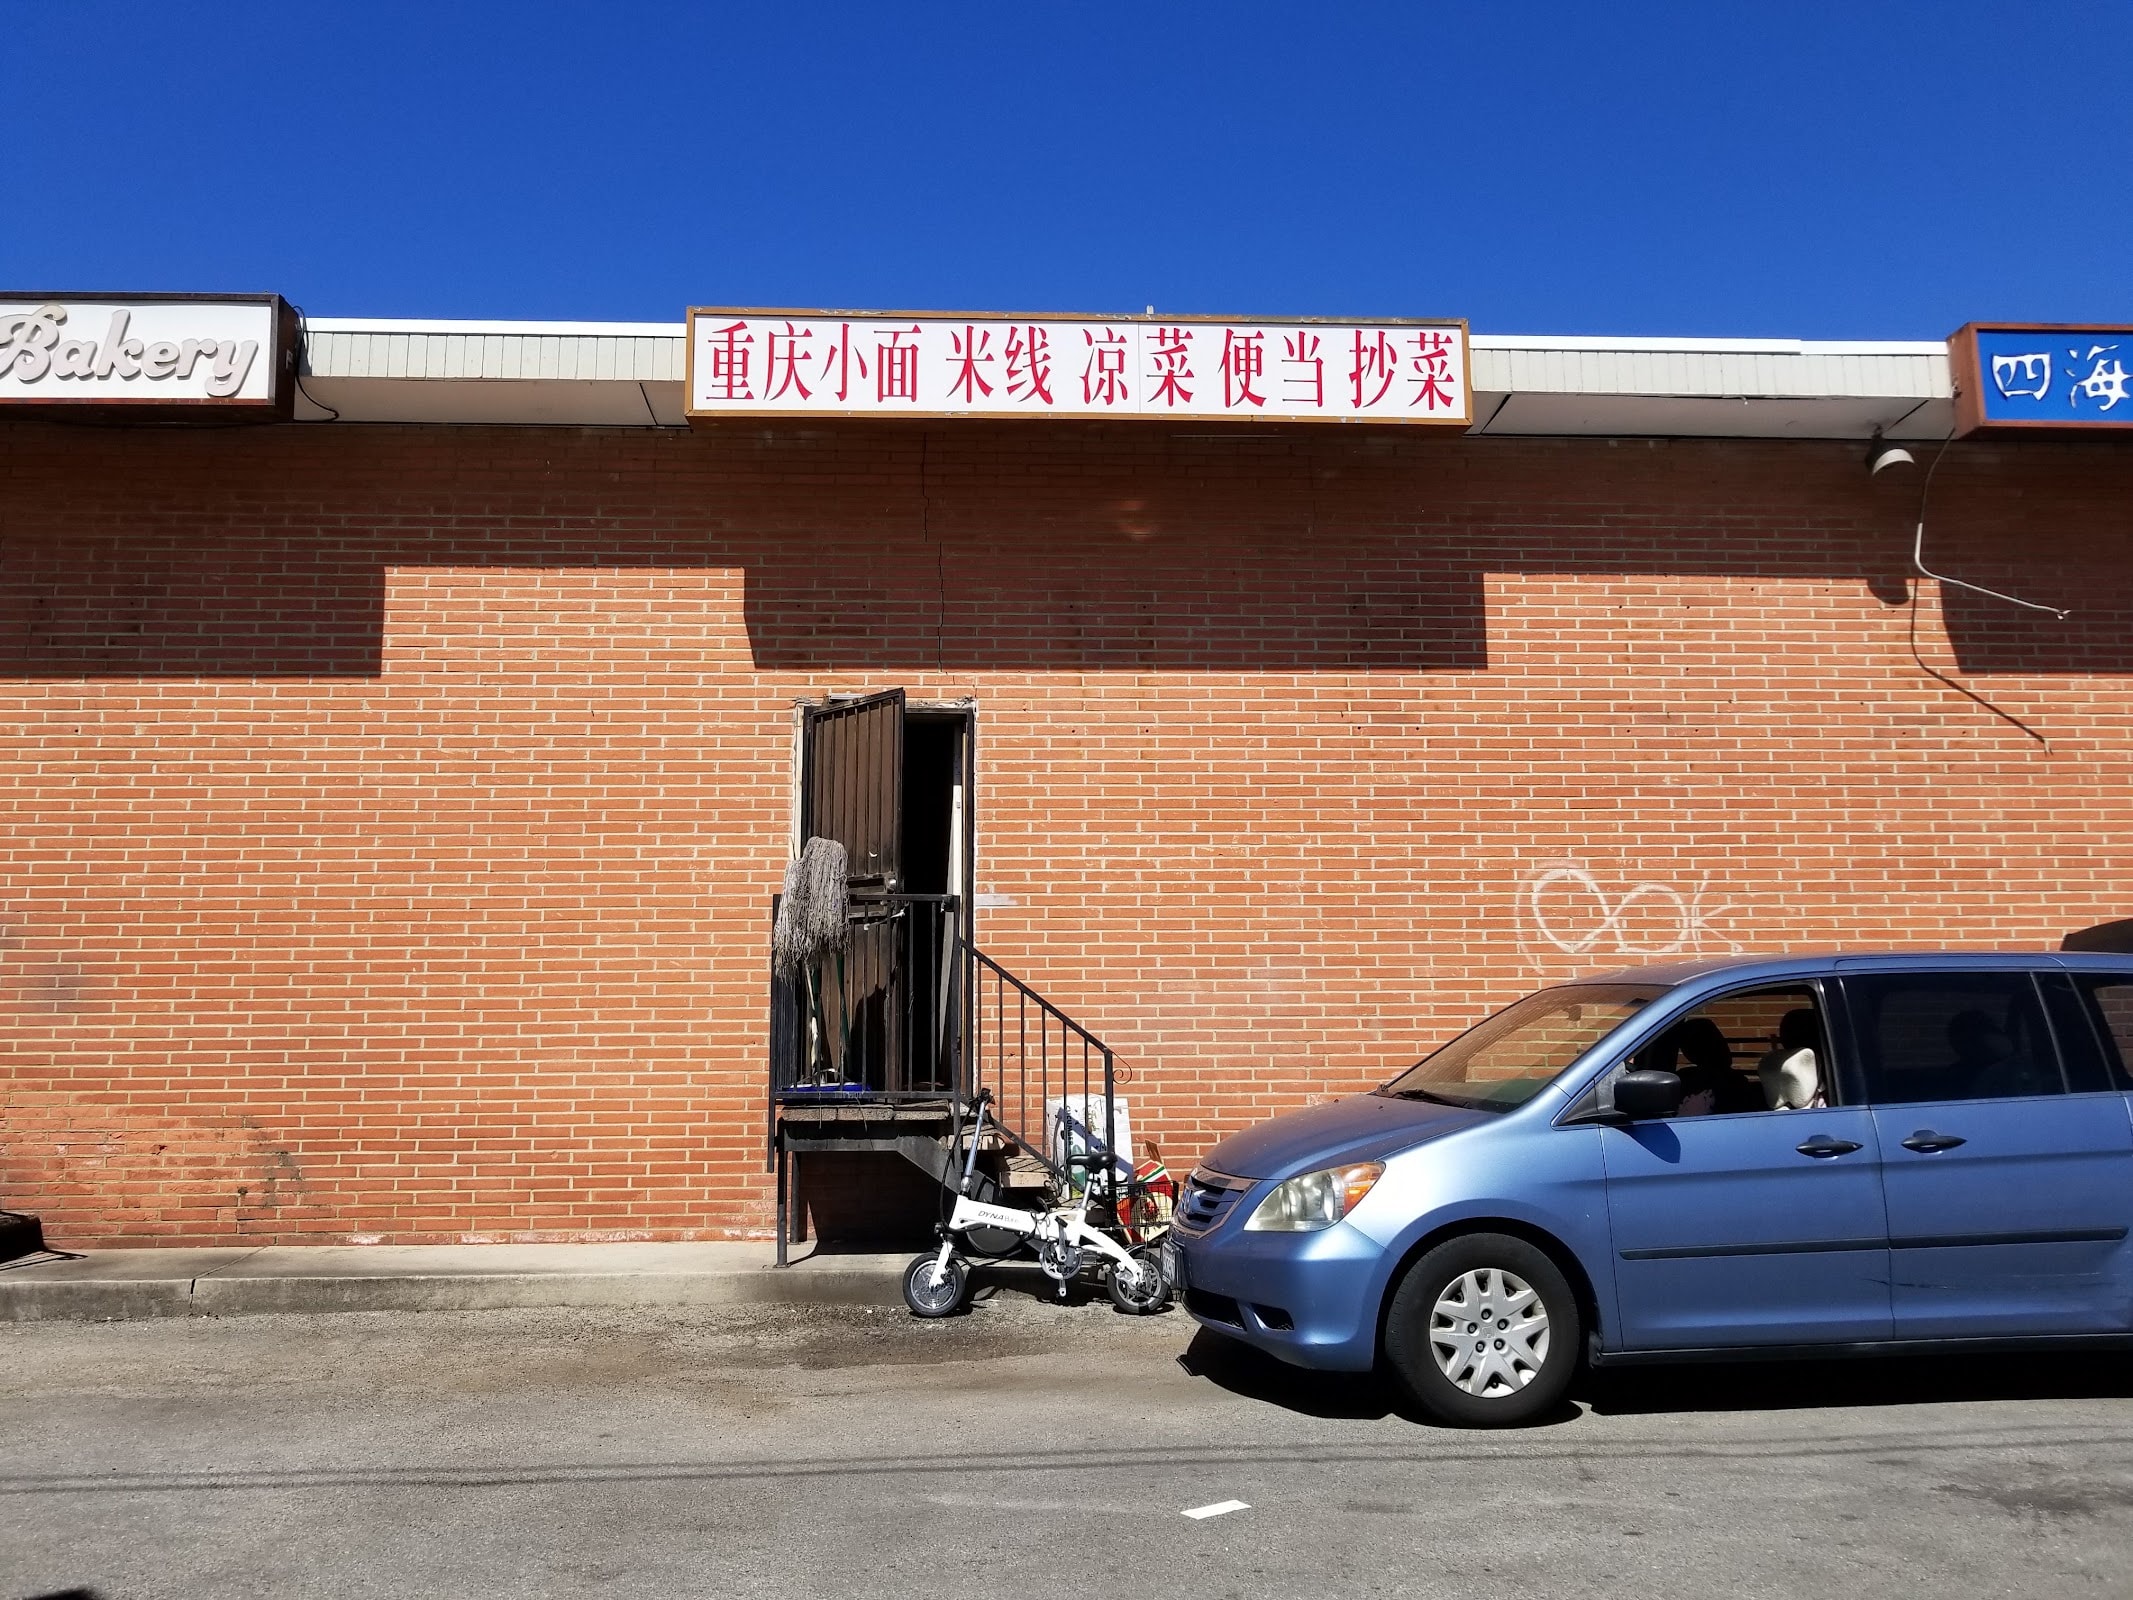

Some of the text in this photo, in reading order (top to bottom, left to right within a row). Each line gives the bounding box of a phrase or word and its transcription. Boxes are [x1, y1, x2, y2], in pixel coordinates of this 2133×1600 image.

[0, 304, 259, 397] Bakery
[706, 321, 1455, 410] 重庆小面 米线 凉菜 便当 抄菜
[1992, 345, 2133, 411] 四海
